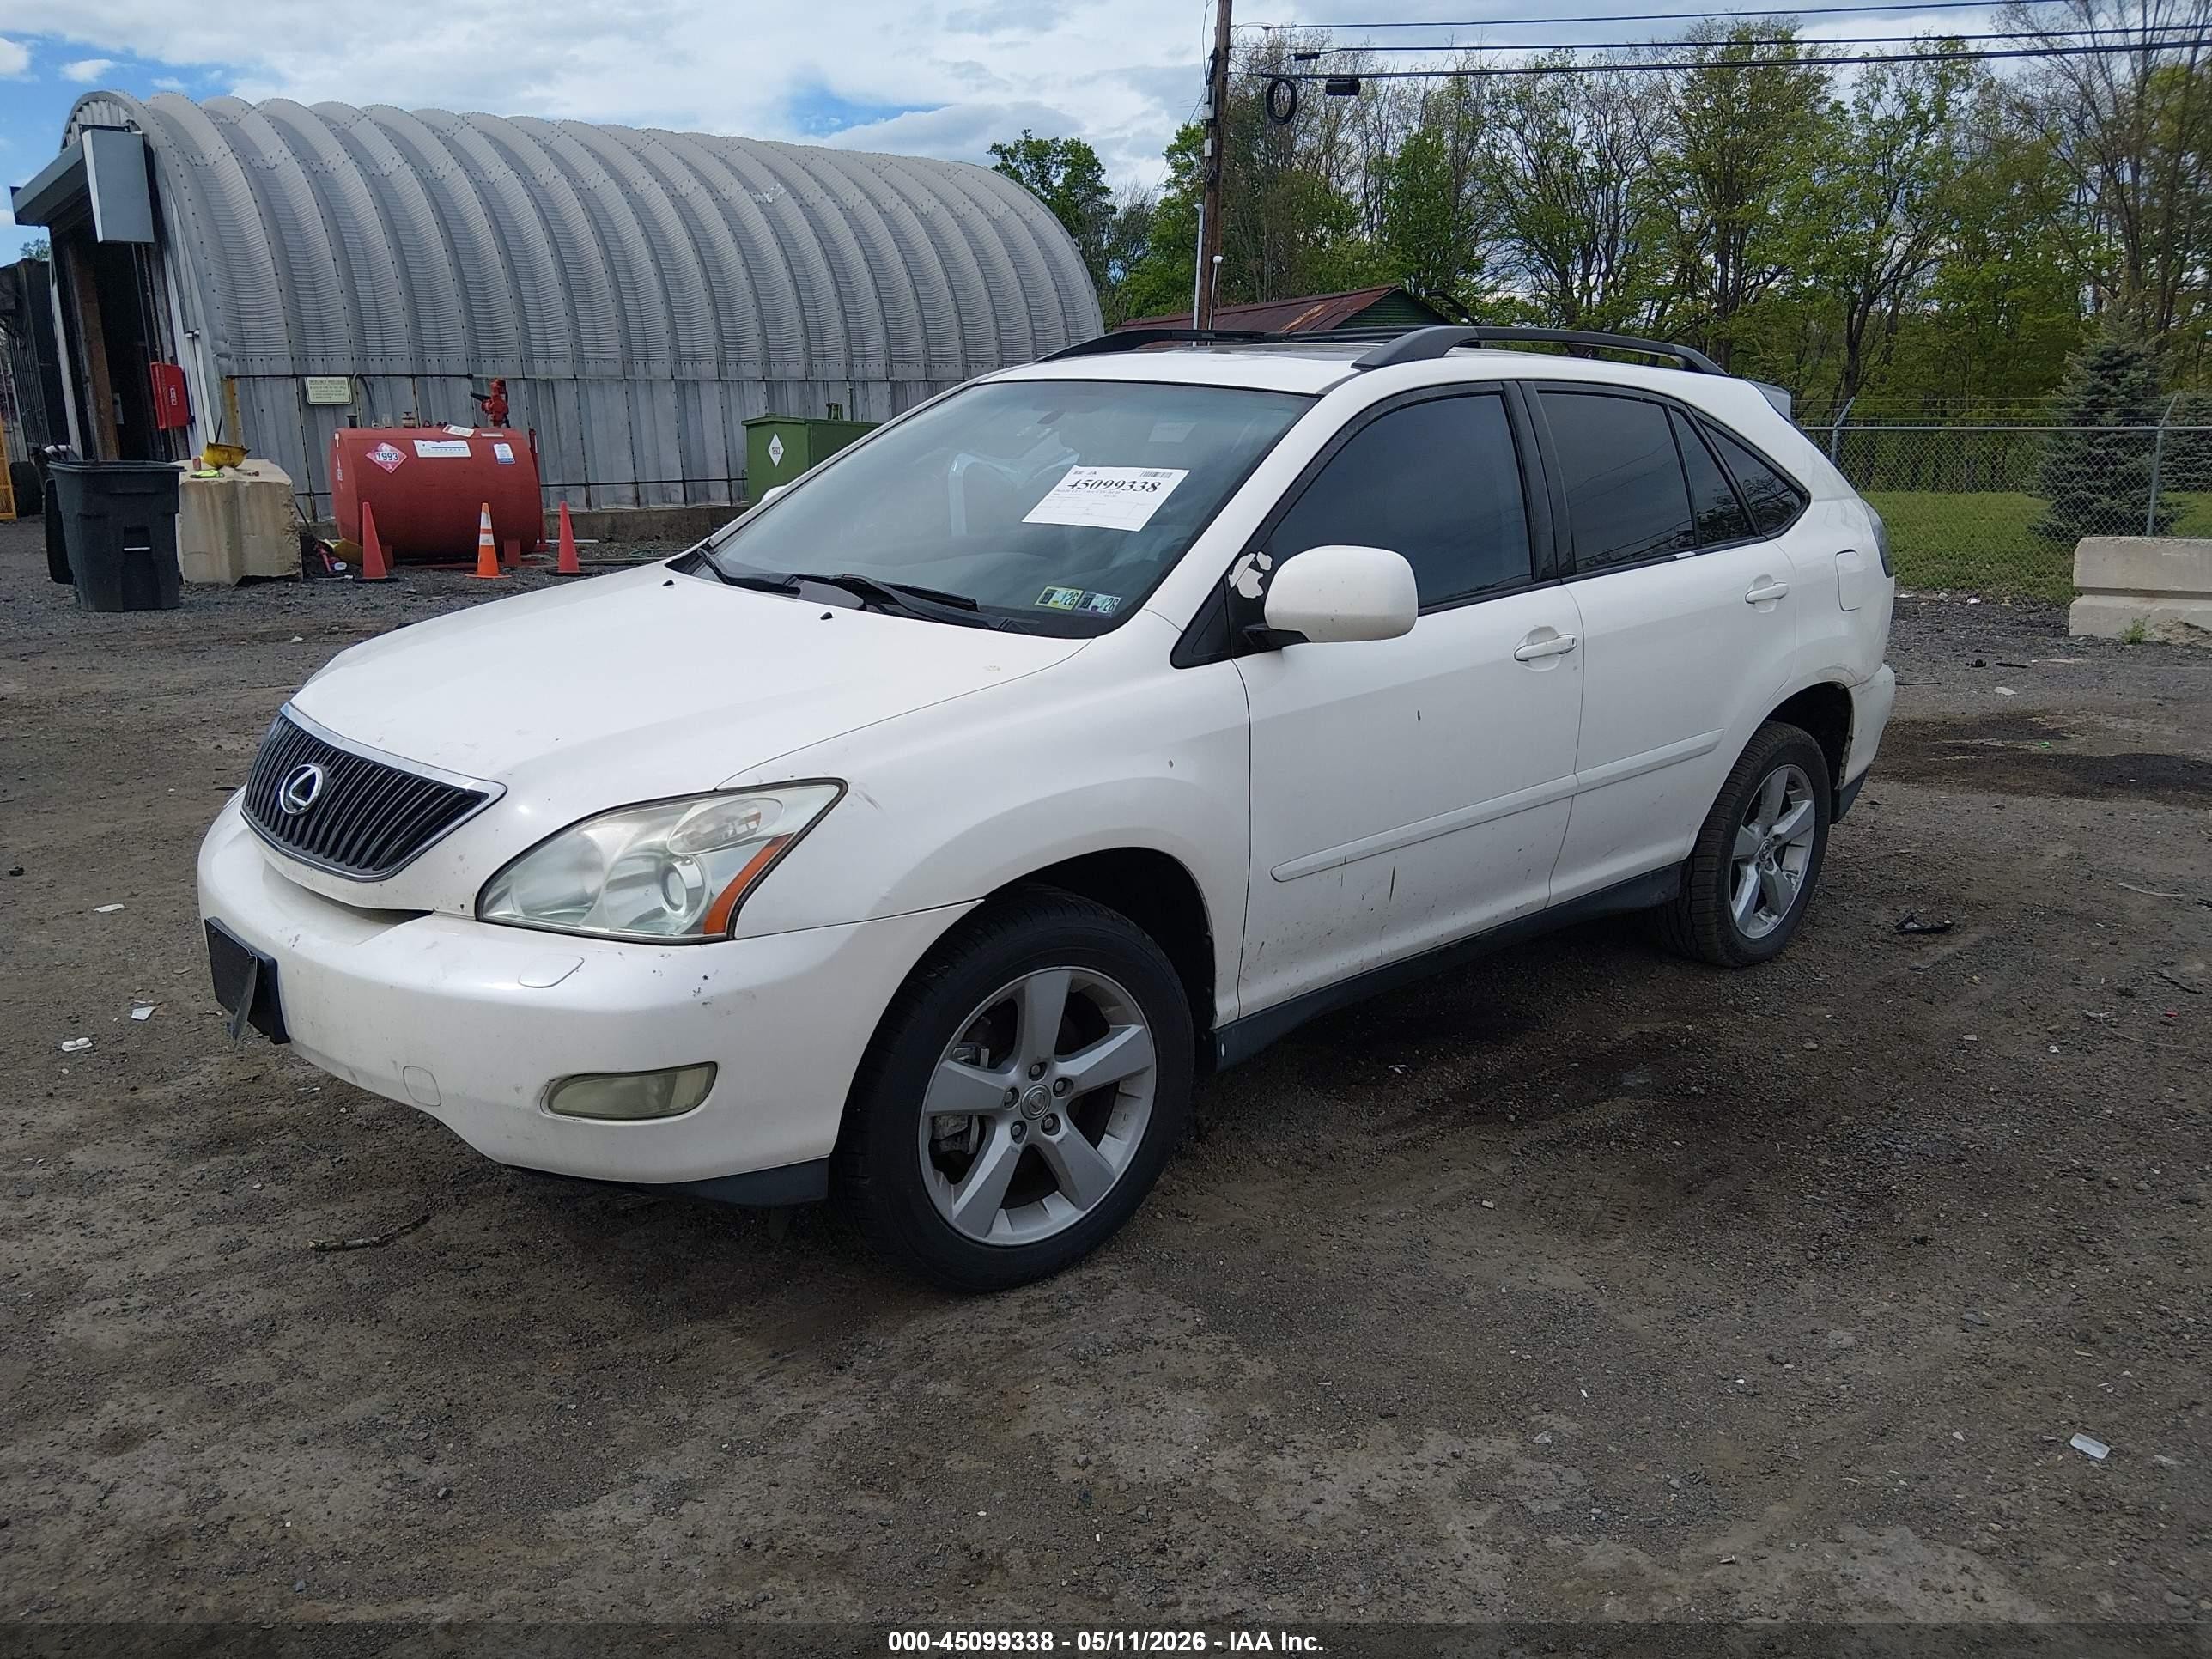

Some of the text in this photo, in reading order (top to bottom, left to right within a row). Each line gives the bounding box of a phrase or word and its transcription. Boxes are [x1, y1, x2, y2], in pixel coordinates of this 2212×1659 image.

[376, 451, 398, 461] 1993
[1067, 478, 1162, 493] 45099338
[1064, 592, 1079, 606] 26
[1103, 597, 1119, 612] 26
